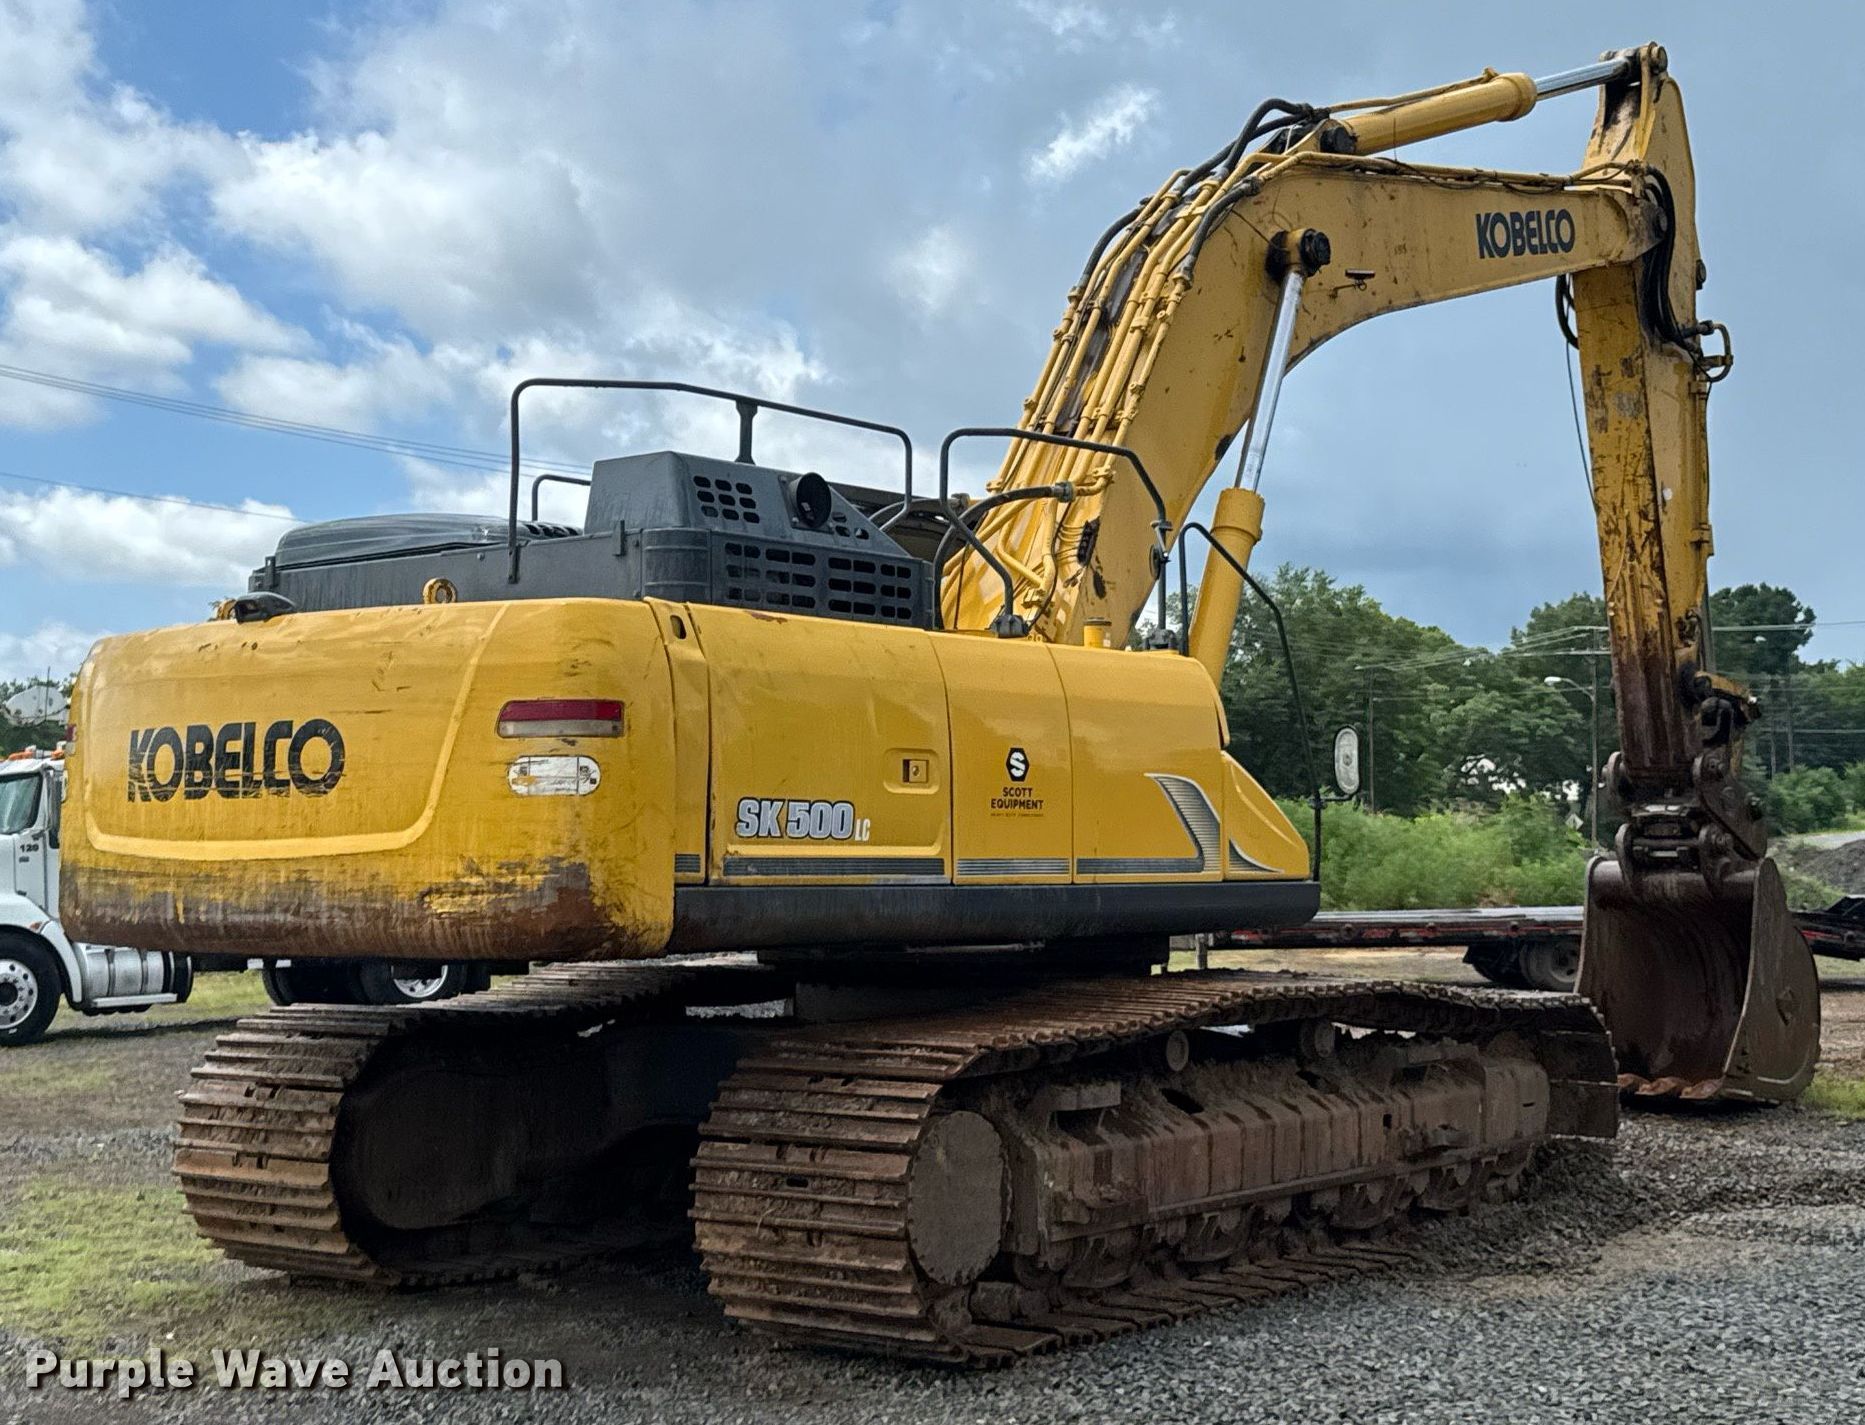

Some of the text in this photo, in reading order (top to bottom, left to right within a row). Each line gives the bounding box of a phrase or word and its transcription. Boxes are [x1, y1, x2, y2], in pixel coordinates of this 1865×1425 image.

[1475, 208, 1575, 259] KOBELCO
[128, 719, 345, 802] KOBELCO
[991, 798, 1044, 809] EQUIPMENT
[1002, 787, 1033, 798] SCOTT
